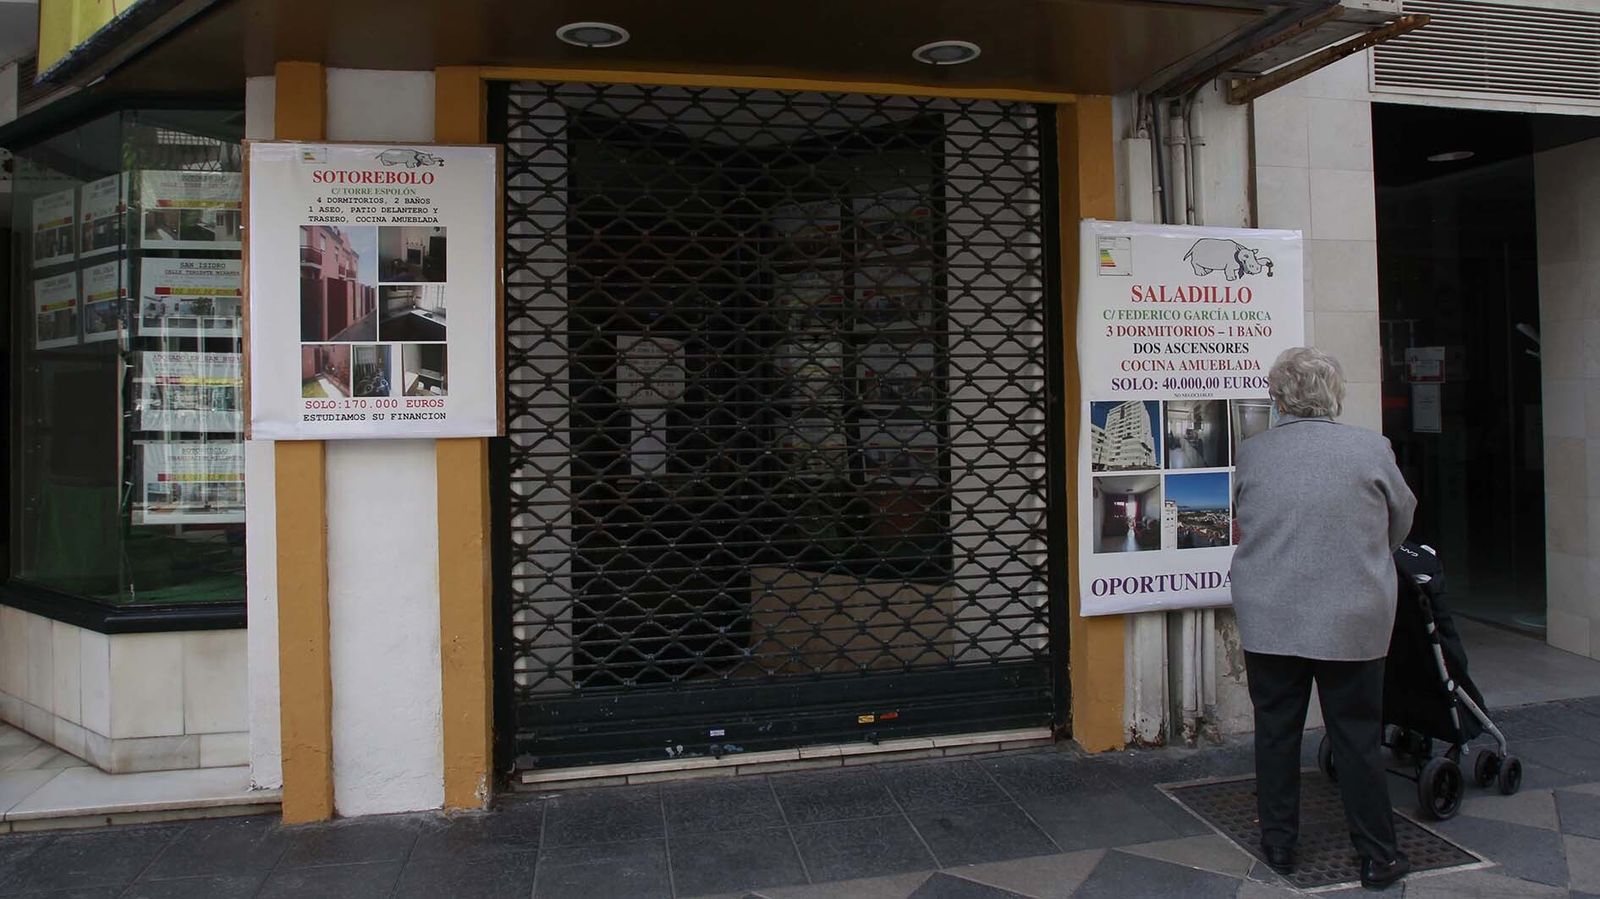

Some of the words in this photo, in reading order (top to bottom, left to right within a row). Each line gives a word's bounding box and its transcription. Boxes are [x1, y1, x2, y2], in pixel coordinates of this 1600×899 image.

[313, 170, 434, 185] SOTOREBOLO
[375, 187, 416, 196] ESPOLÓN
[327, 197, 387, 205] DORMITORIOS,
[405, 197, 430, 205] BAÑOS
[319, 206, 345, 214] ASEO,
[309, 216, 349, 224] TRASERO,
[1132, 285, 1252, 304] SALADILLO
[1103, 310, 1115, 321] C/
[1119, 310, 1180, 320] FEDERICO
[1184, 307, 1229, 320] GARCÍA
[1233, 311, 1271, 321] LORCA
[1106, 326, 1113, 337] 3
[1116, 326, 1215, 337] DORMITORIOS
[1229, 326, 1233, 336] 1
[1237, 323, 1272, 337] BAÑO
[1134, 343, 1161, 354] DOS
[1164, 343, 1249, 354] ASCENSORES
[1121, 360, 1174, 371] COCINA
[1179, 360, 1260, 371] AMUEBLADA
[1112, 378, 1158, 391] SOLO:
[1162, 377, 1220, 392] 40.000,00
[1224, 377, 1269, 389] EUROS
[406, 400, 444, 408] EUROS
[303, 414, 366, 422] ESTUDIAMOS
[391, 413, 446, 421] FINANCION
